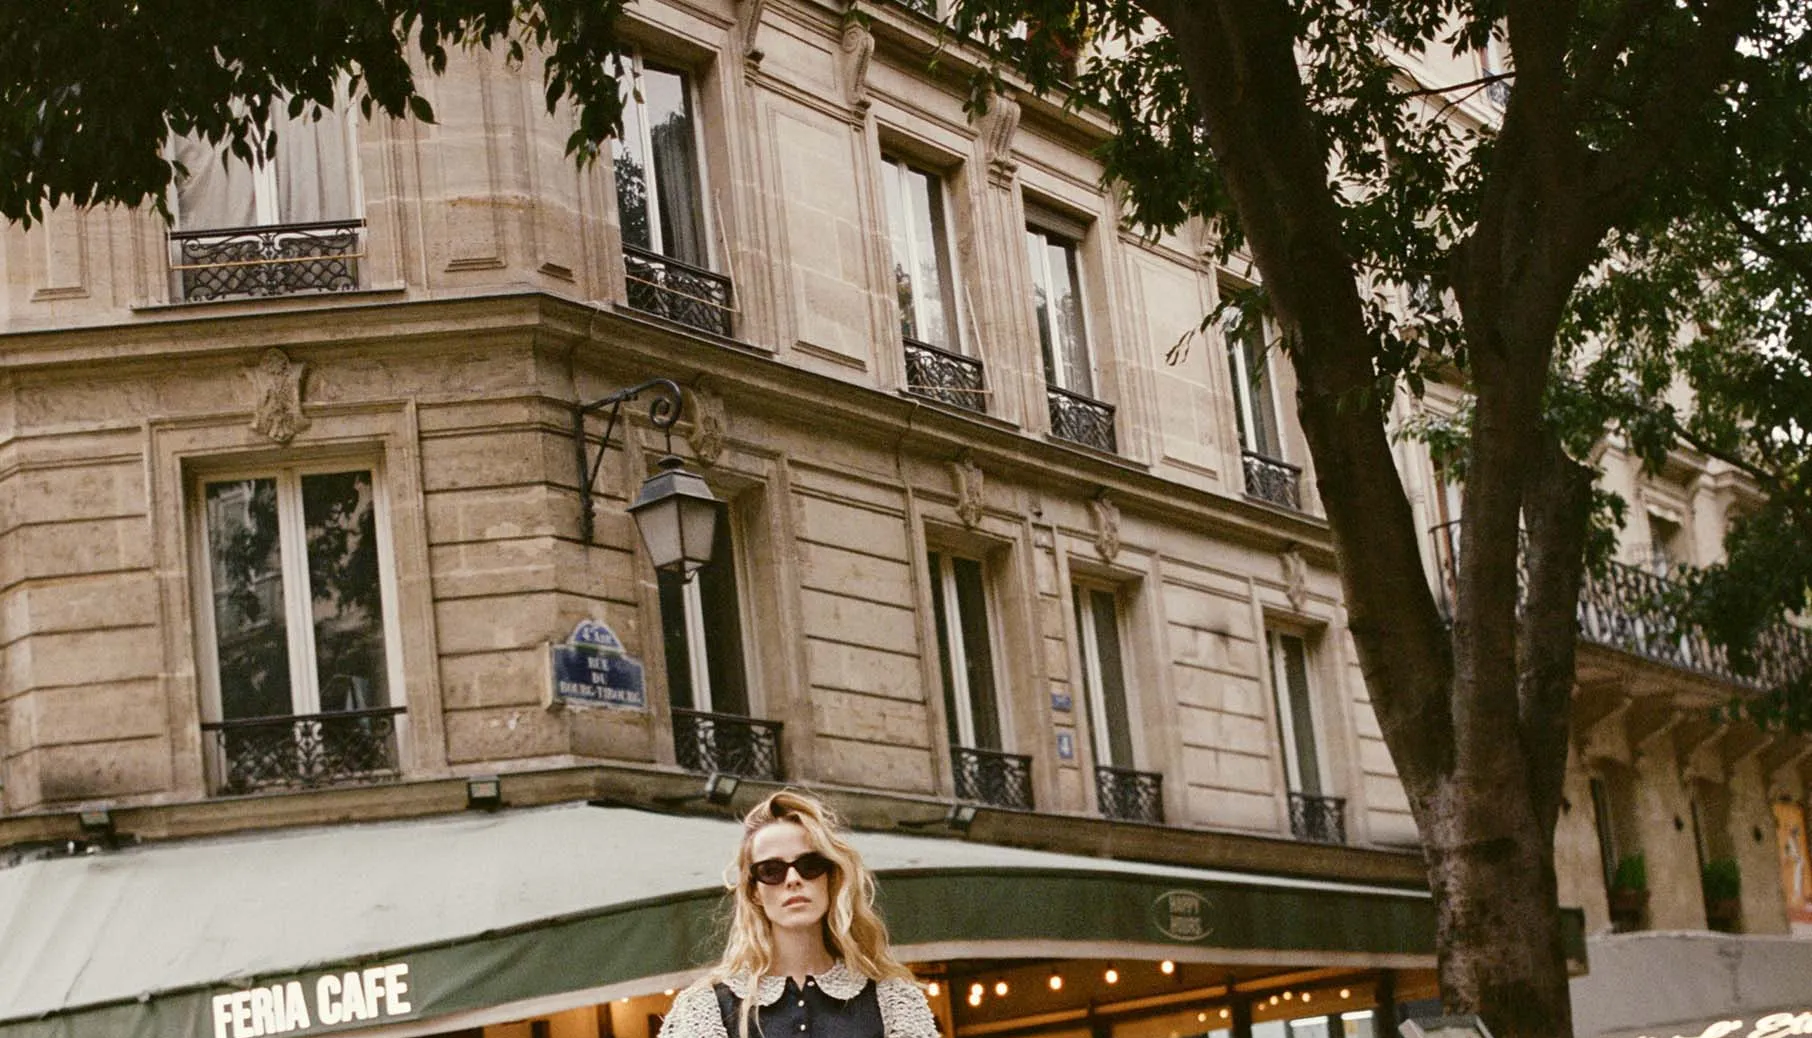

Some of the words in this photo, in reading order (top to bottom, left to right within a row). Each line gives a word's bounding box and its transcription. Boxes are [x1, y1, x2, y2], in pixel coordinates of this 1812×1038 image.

[587, 657, 609, 671] RUE
[591, 672, 606, 684] DU
[316, 963, 412, 1026] CAFE
